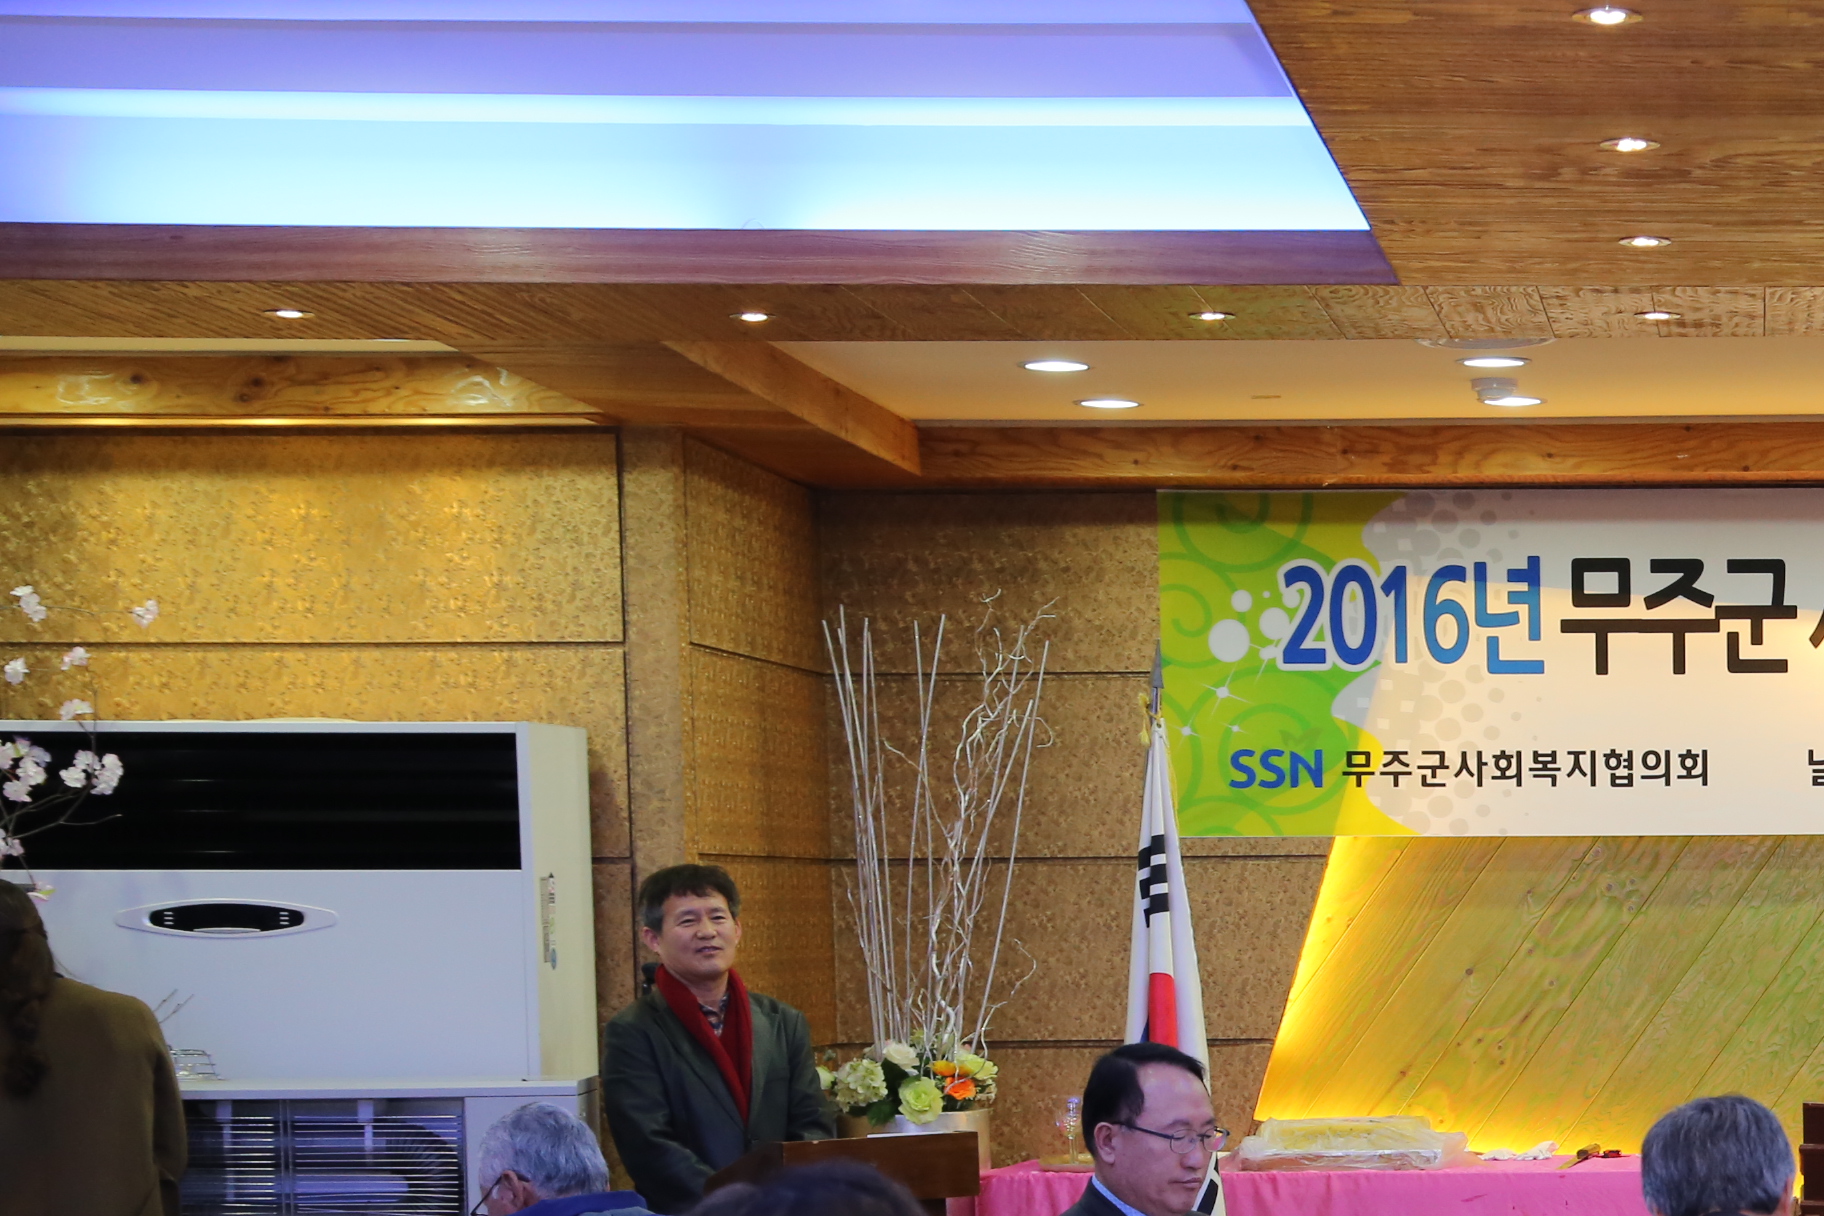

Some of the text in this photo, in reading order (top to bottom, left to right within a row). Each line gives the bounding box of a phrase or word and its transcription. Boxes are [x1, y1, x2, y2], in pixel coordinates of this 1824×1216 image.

[1280, 555, 1546, 675] 2016년
[1560, 556, 1798, 676] 무주군
[1229, 748, 1324, 789] SSN
[1341, 748, 1710, 788] 무주군사회복지협의회
